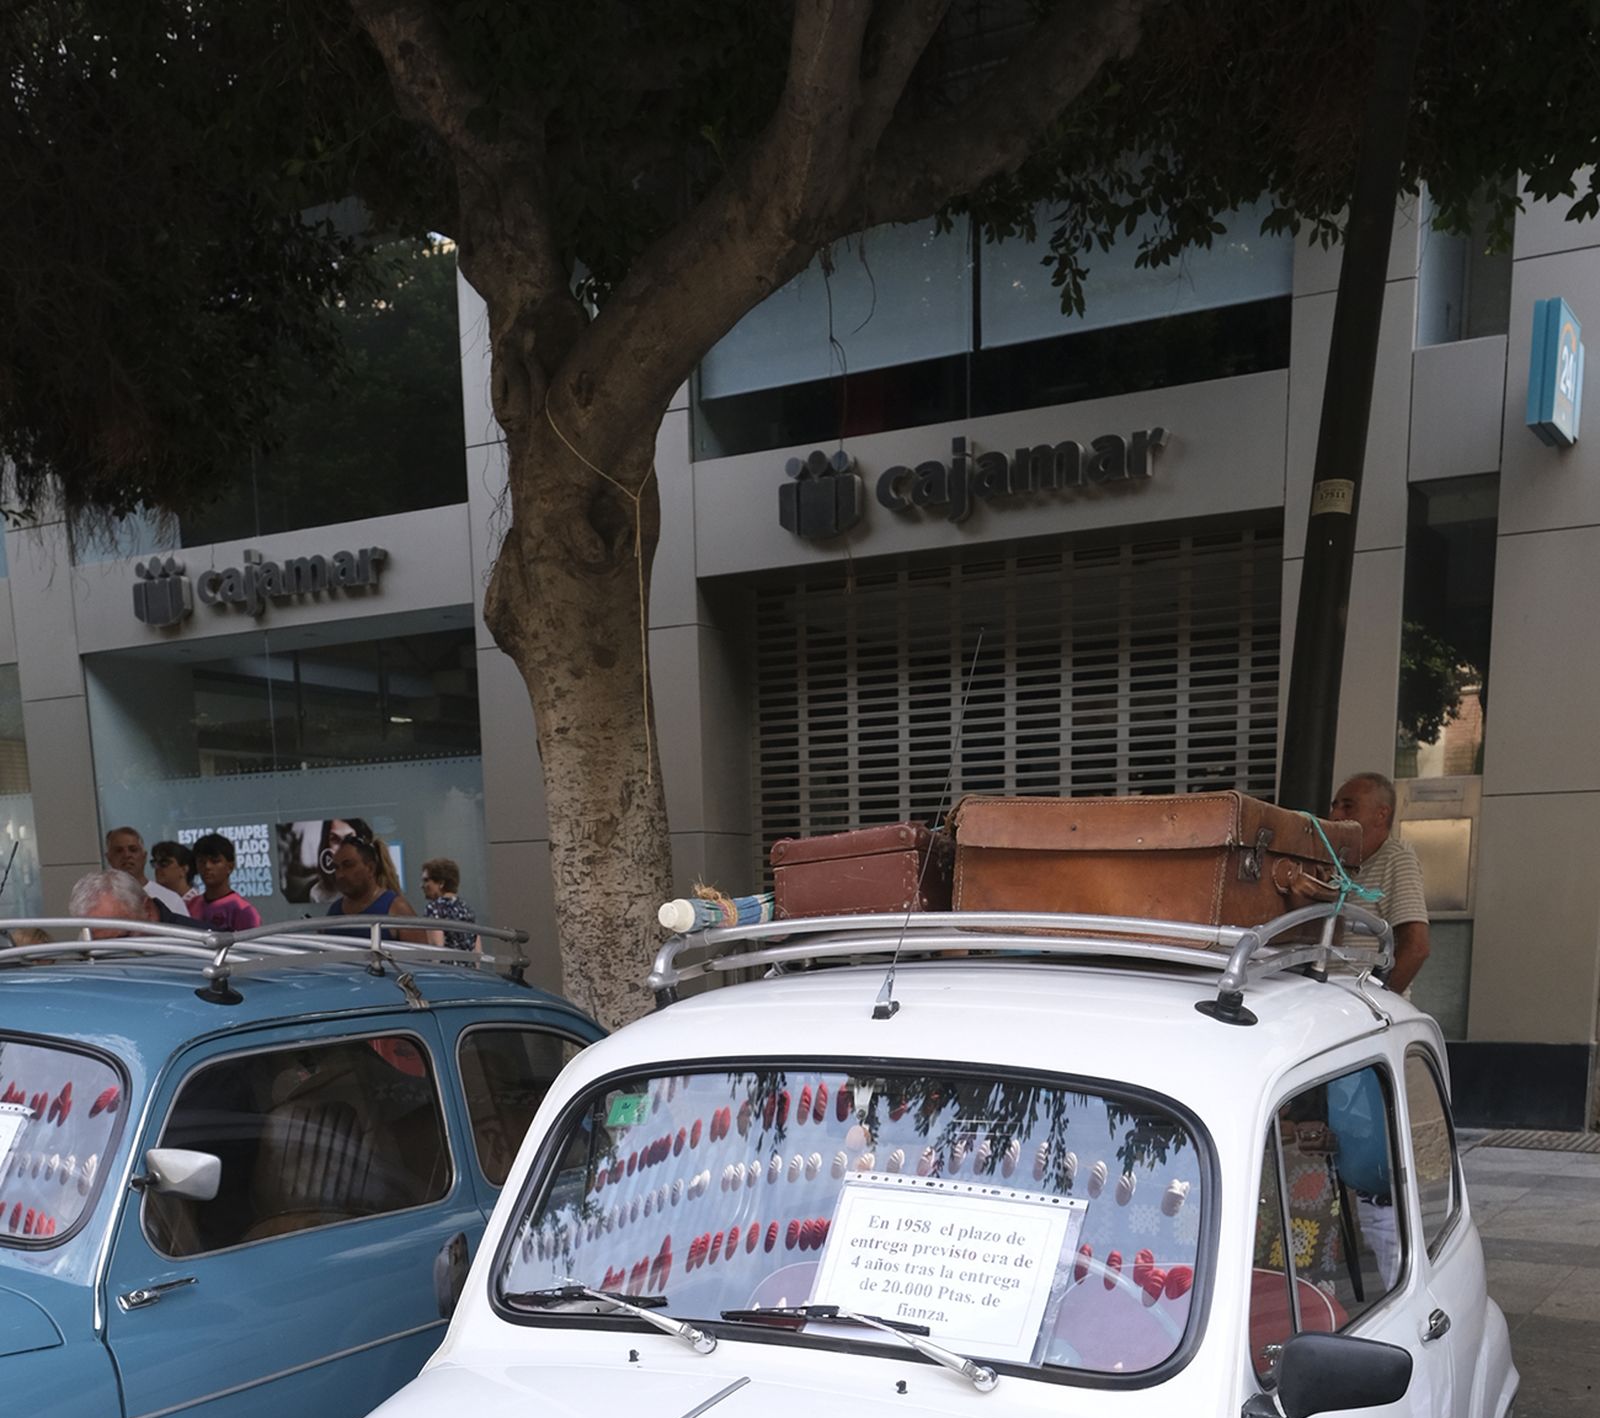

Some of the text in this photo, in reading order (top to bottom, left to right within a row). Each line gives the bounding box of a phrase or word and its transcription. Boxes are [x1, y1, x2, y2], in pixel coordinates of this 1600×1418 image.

[876, 427, 1169, 524] cajamar
[198, 546, 387, 617] cajamar
[235, 839, 270, 854] LADO
[236, 853, 271, 868] PARA
[868, 1215, 1026, 1246] En 1958 el plazo de
[850, 1235, 1034, 1269] entrega previsto era de
[850, 1255, 1021, 1291] 4 años tras la entrega
[859, 1277, 1002, 1308] de 20.000 Ptas. de
[896, 1302, 949, 1322] fianza.
